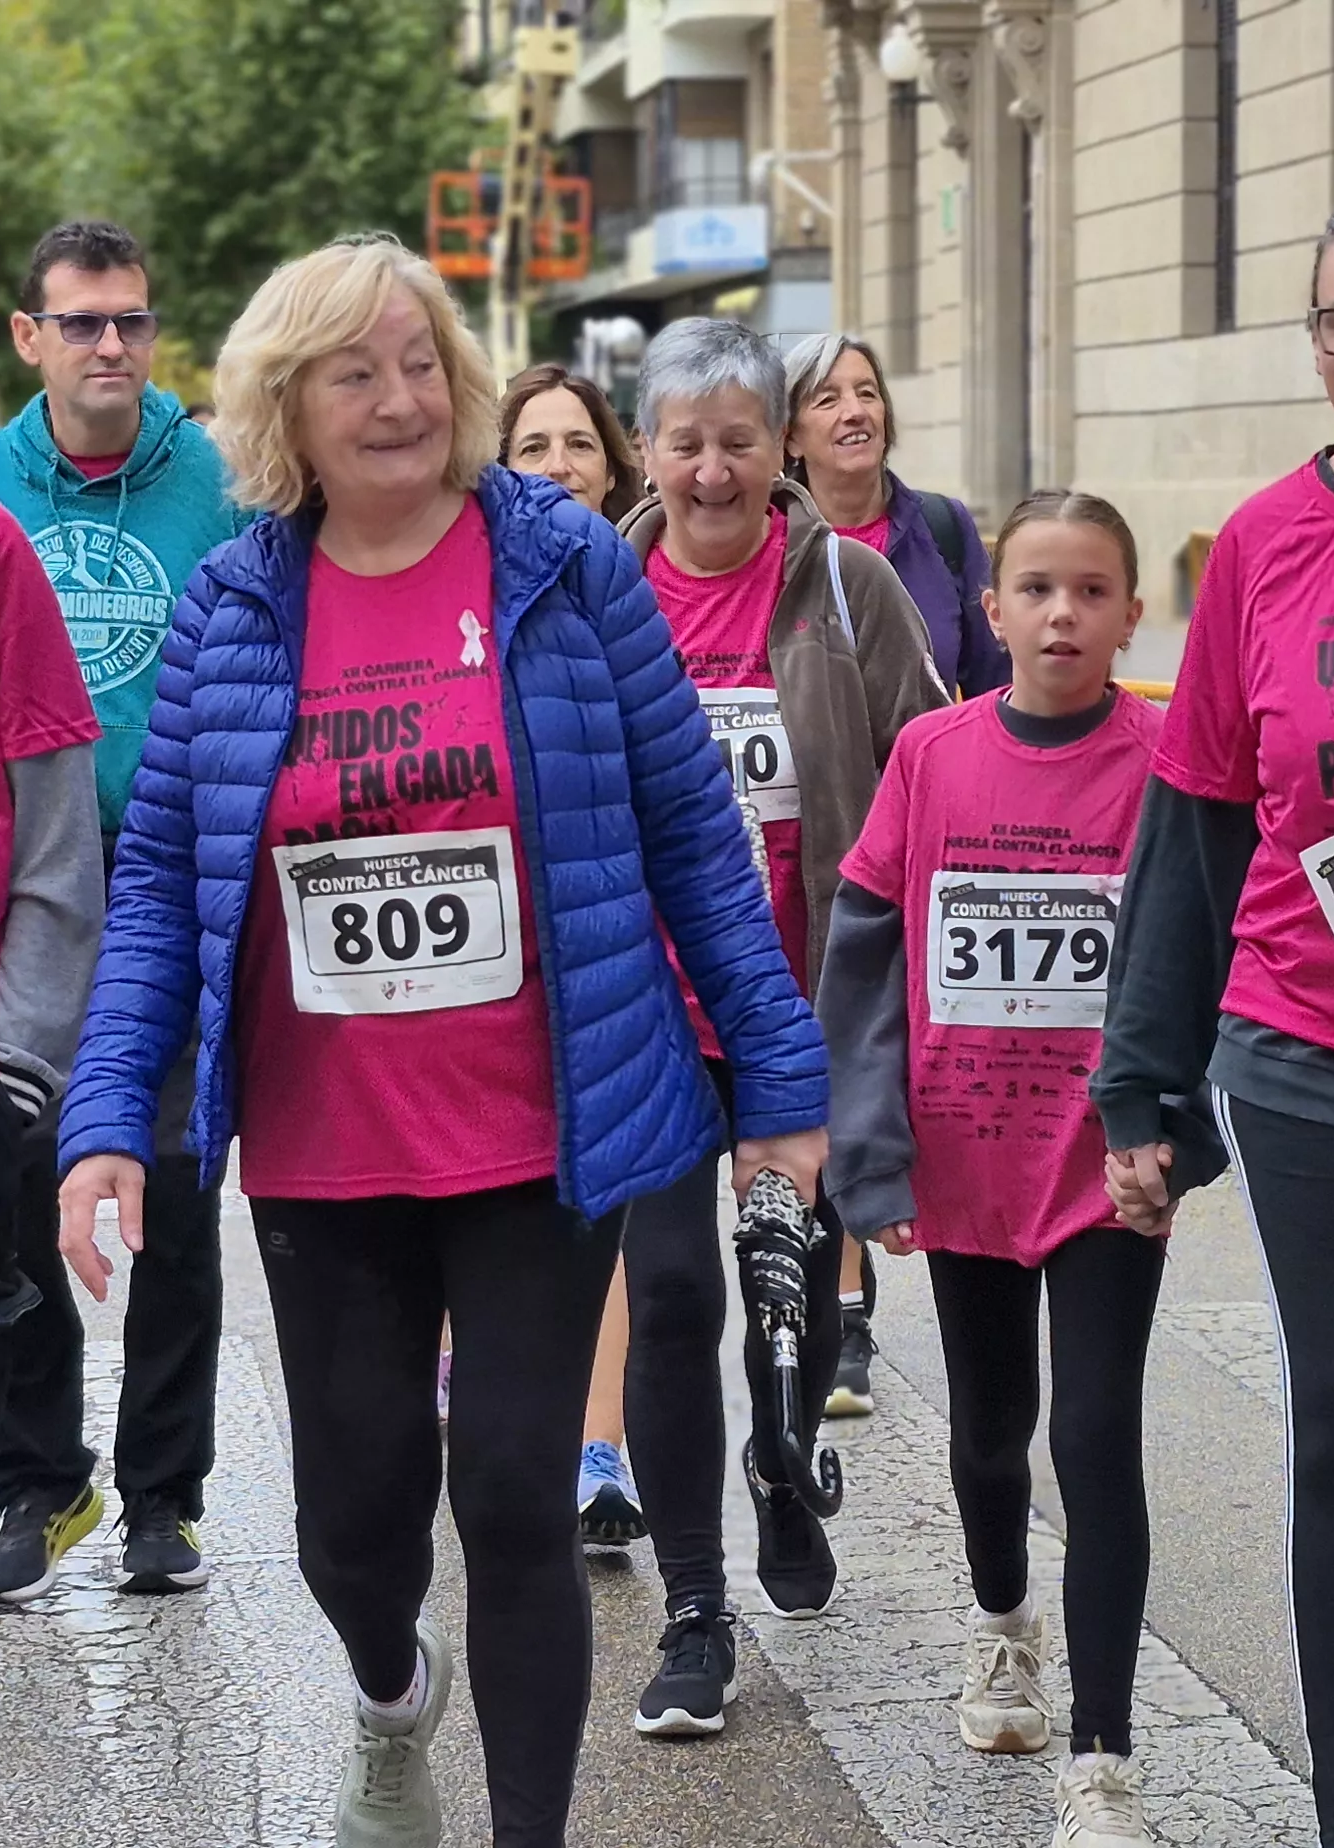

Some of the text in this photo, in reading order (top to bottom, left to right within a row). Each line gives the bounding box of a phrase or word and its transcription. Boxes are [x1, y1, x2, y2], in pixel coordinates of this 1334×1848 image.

[37, 533, 64, 559] AFIO
[81, 627, 152, 683] ON DESERT
[363, 658, 435, 677] CARRERA
[345, 678, 408, 695] CONTRA
[411, 674, 428, 686] EL
[702, 705, 740, 716] UESCA
[731, 710, 783, 728] CÁNCE
[718, 734, 778, 783] 10
[340, 742, 500, 814] EN CADA
[1010, 824, 1071, 840] CARRERA
[993, 839, 1045, 853] CONTRA
[363, 855, 420, 872] HUESCA
[307, 864, 488, 894] CONTRA EL CÁNCER
[999, 892, 1049, 903] HUESCA
[950, 901, 1107, 919] CONTRA EL CÁNCER
[332, 893, 471, 966] 809
[945, 926, 1110, 984] 3179
